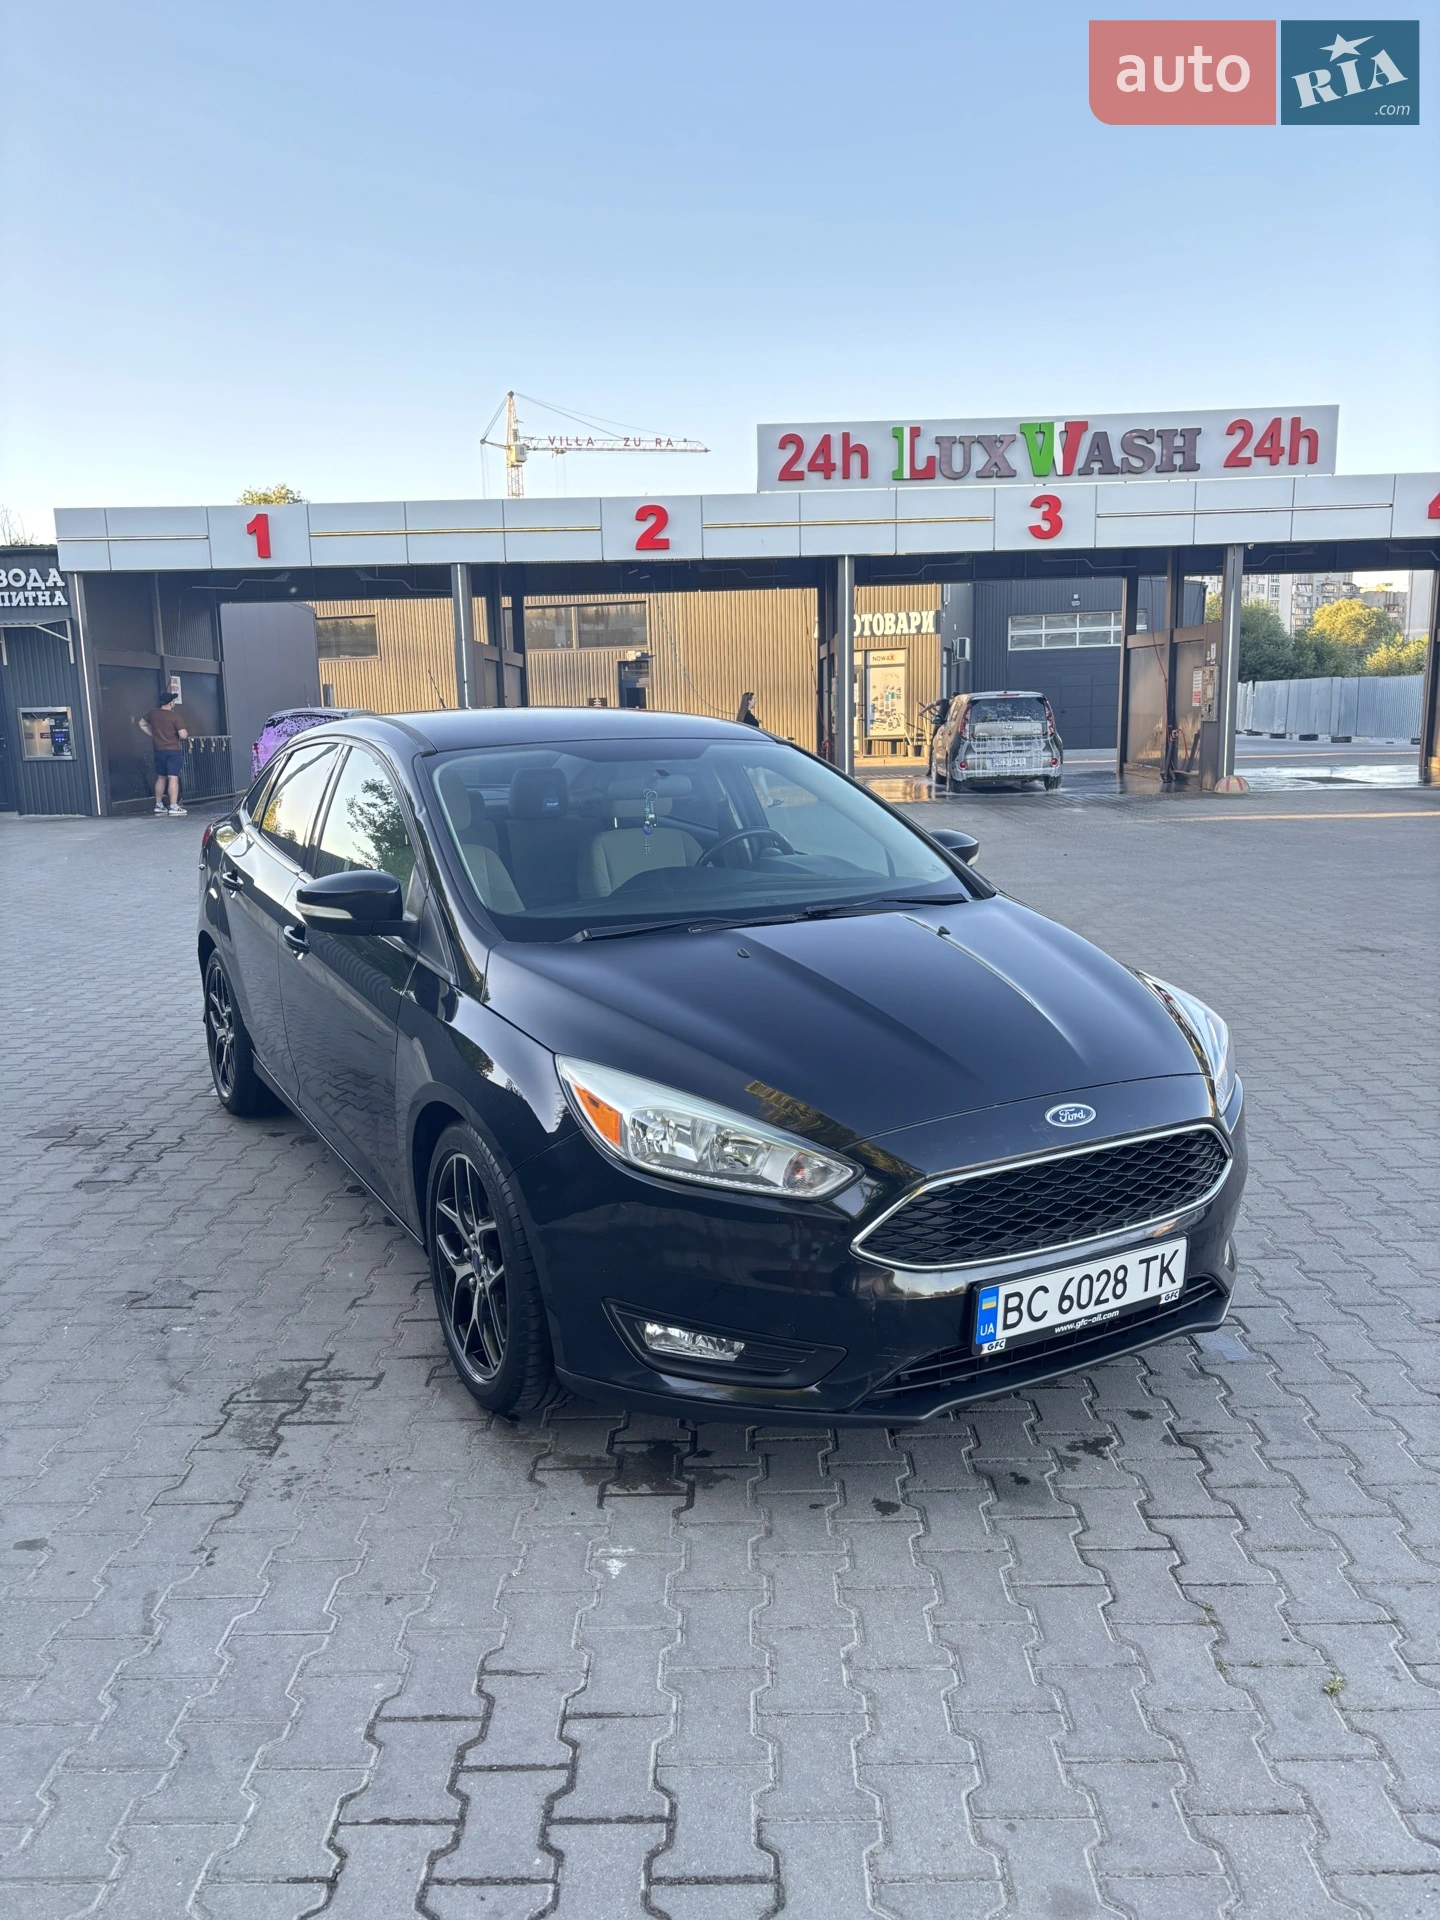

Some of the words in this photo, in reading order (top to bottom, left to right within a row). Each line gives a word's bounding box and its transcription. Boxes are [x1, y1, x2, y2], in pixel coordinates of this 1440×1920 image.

[548, 436, 595, 447] VILLA
[777, 432, 869, 481] 24h
[1223, 417, 1320, 468] 24h
[246, 513, 271, 558] 1
[635, 504, 670, 550] 2
[1028, 494, 1063, 539] 3
[1059, 1108, 1086, 1123] Ford
[1002, 1285, 1050, 1331] BC
[1057, 1264, 1128, 1315] 6028
[1138, 1249, 1180, 1293] TK
[980, 1323, 996, 1336] UA
[1054, 1309, 1120, 1334] www.gfc-oil.com
